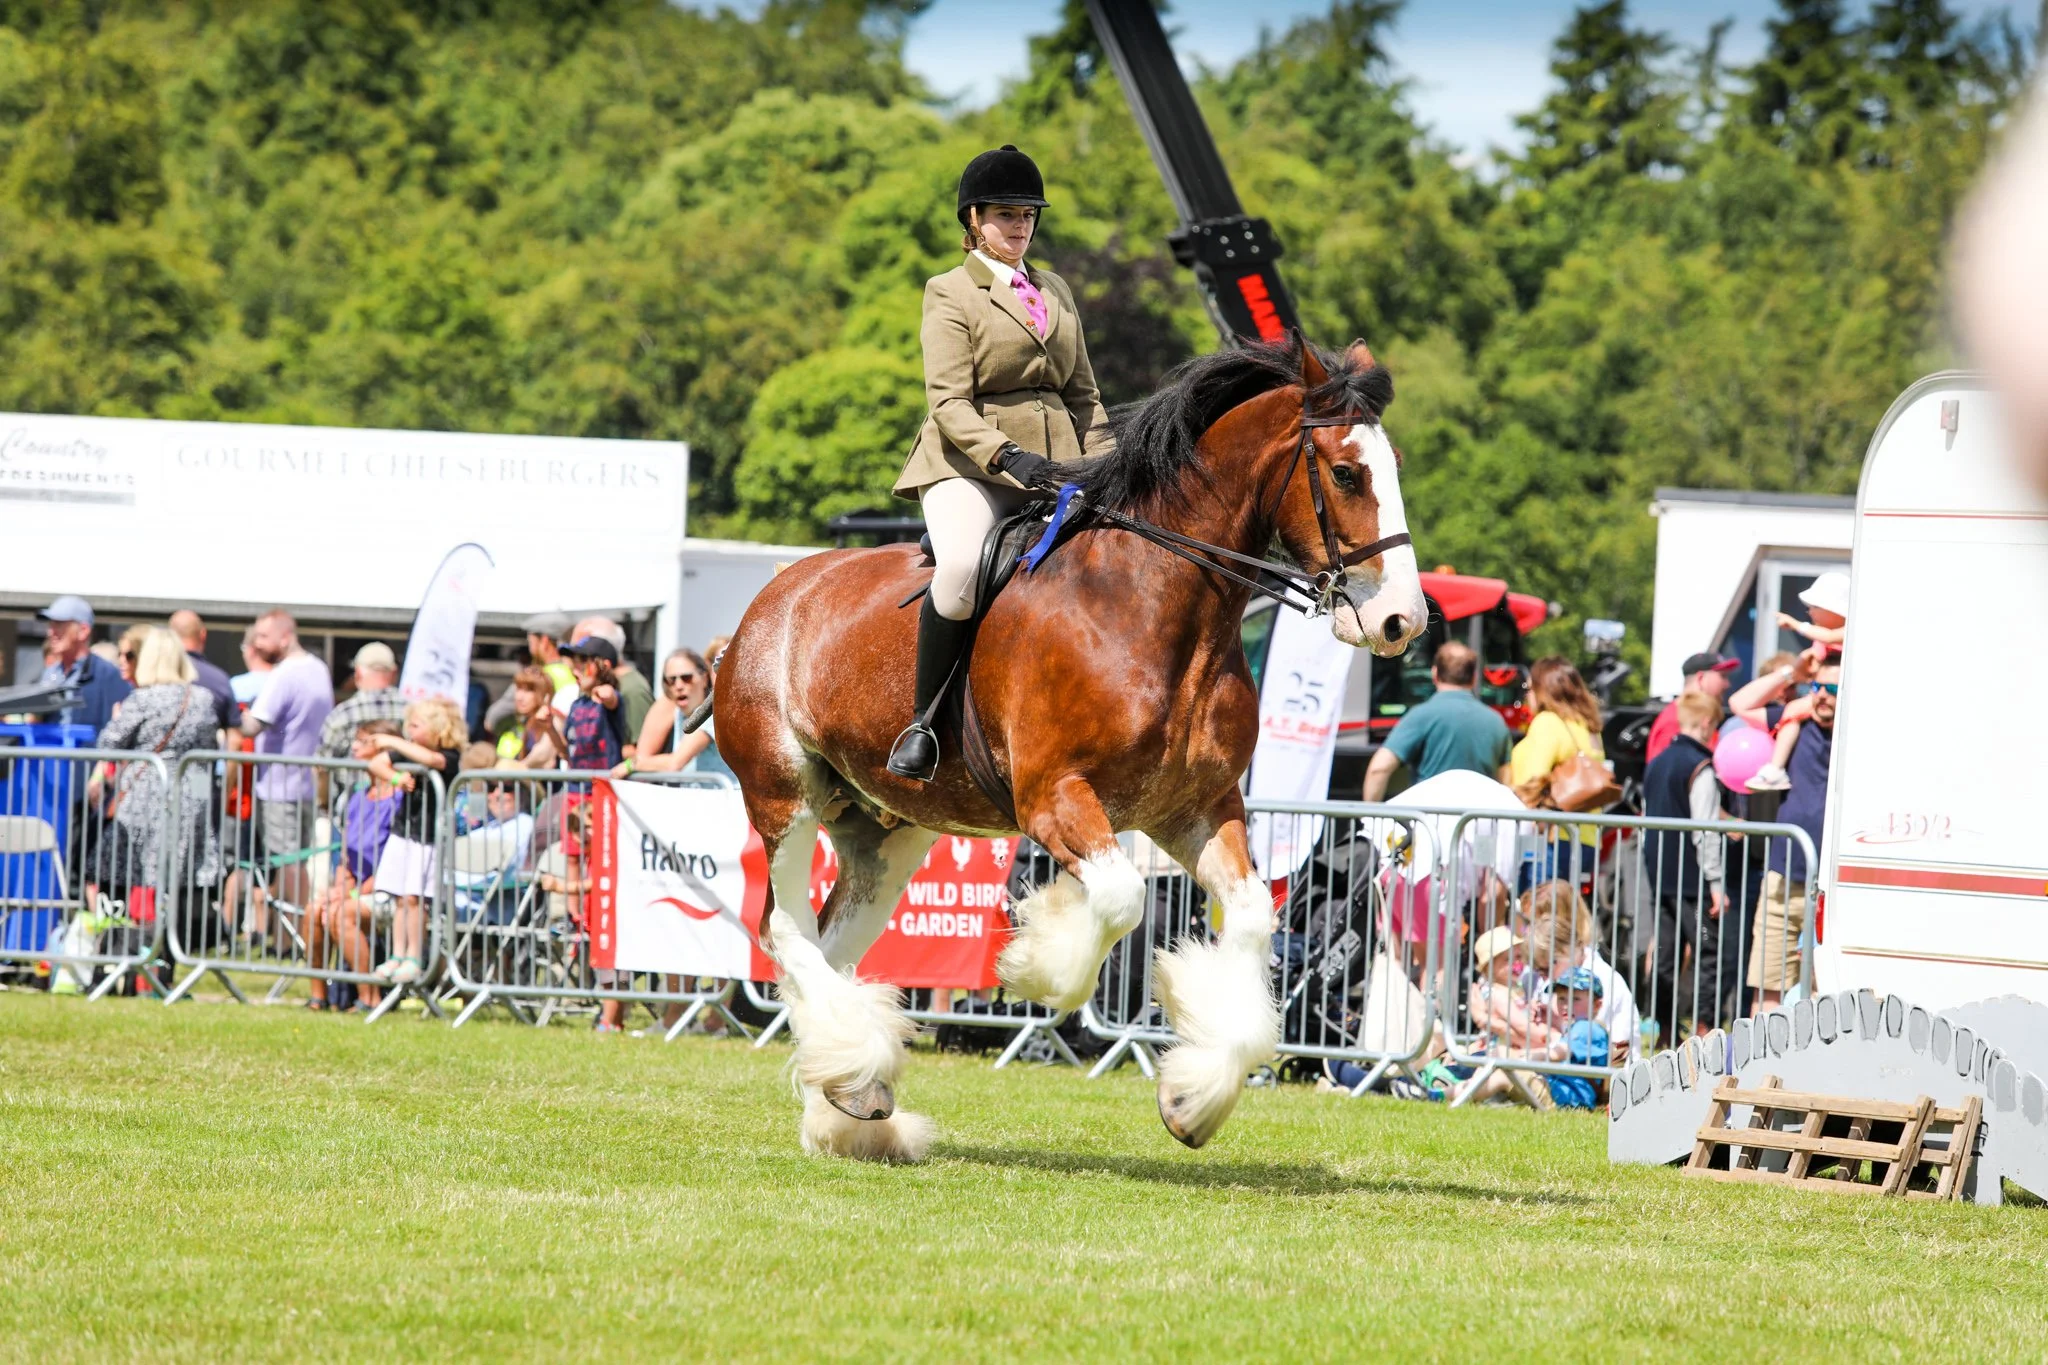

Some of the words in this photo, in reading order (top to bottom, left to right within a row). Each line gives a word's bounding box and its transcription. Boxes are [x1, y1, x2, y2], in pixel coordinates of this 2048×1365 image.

[175, 445, 349, 477] GOURMET
[363, 450, 663, 488] CHEESEBURGERS
[640, 833, 718, 880] Habro
[907, 881, 958, 908] WILD
[900, 911, 984, 938] GARDEN
